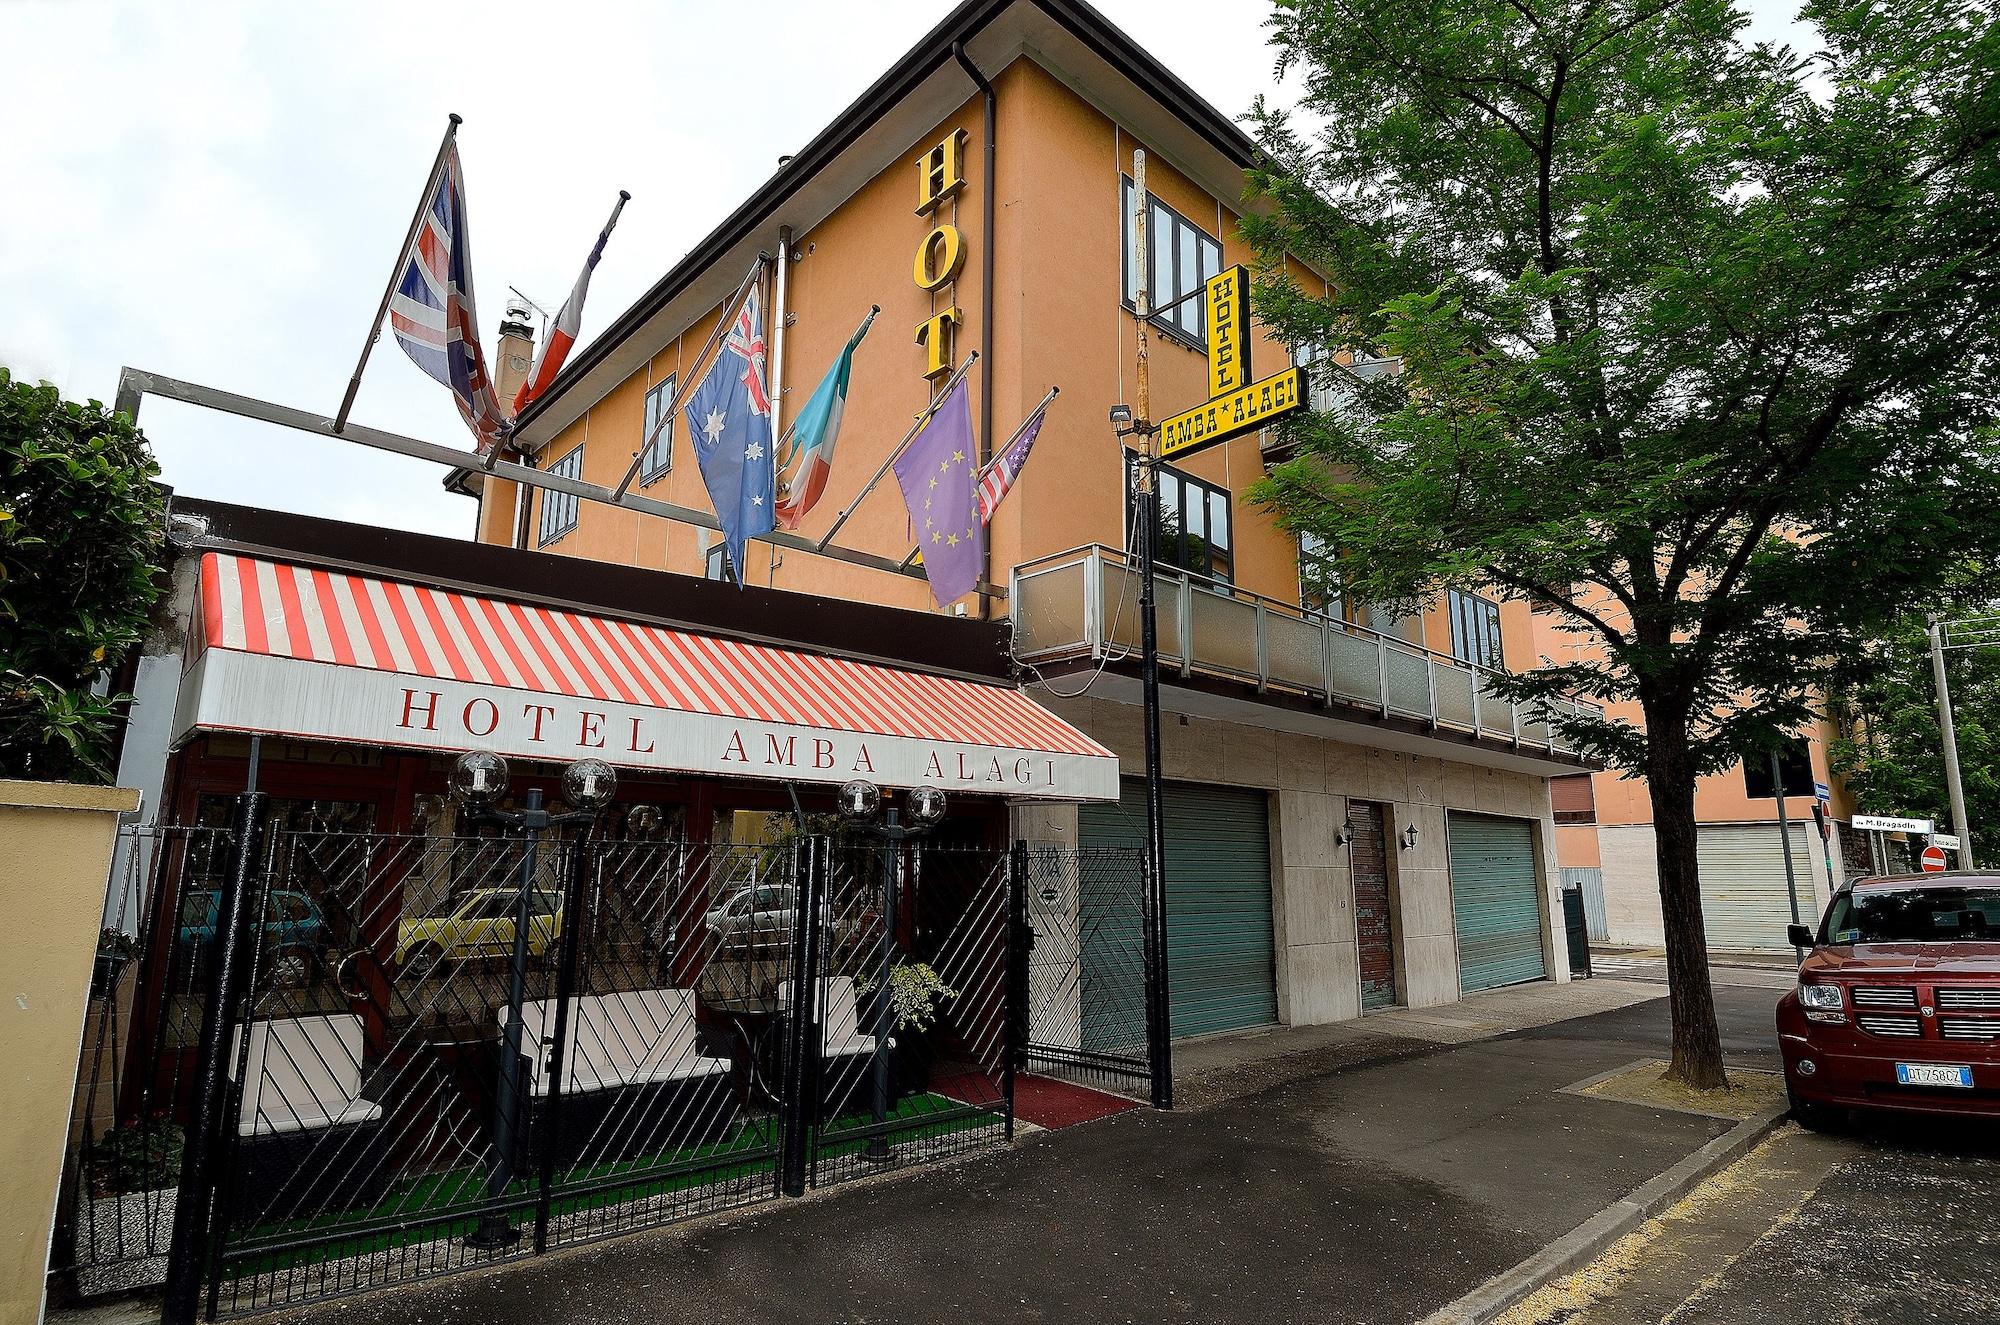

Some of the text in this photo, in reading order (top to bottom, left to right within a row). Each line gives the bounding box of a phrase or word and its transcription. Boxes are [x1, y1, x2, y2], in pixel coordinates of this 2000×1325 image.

[913, 127, 968, 435] HOT
[1213, 277, 1233, 389] HOTEL
[1165, 376, 1294, 449] AMBA ALAGI
[395, 688, 1056, 787] HOTEL AMBA ALAGI
